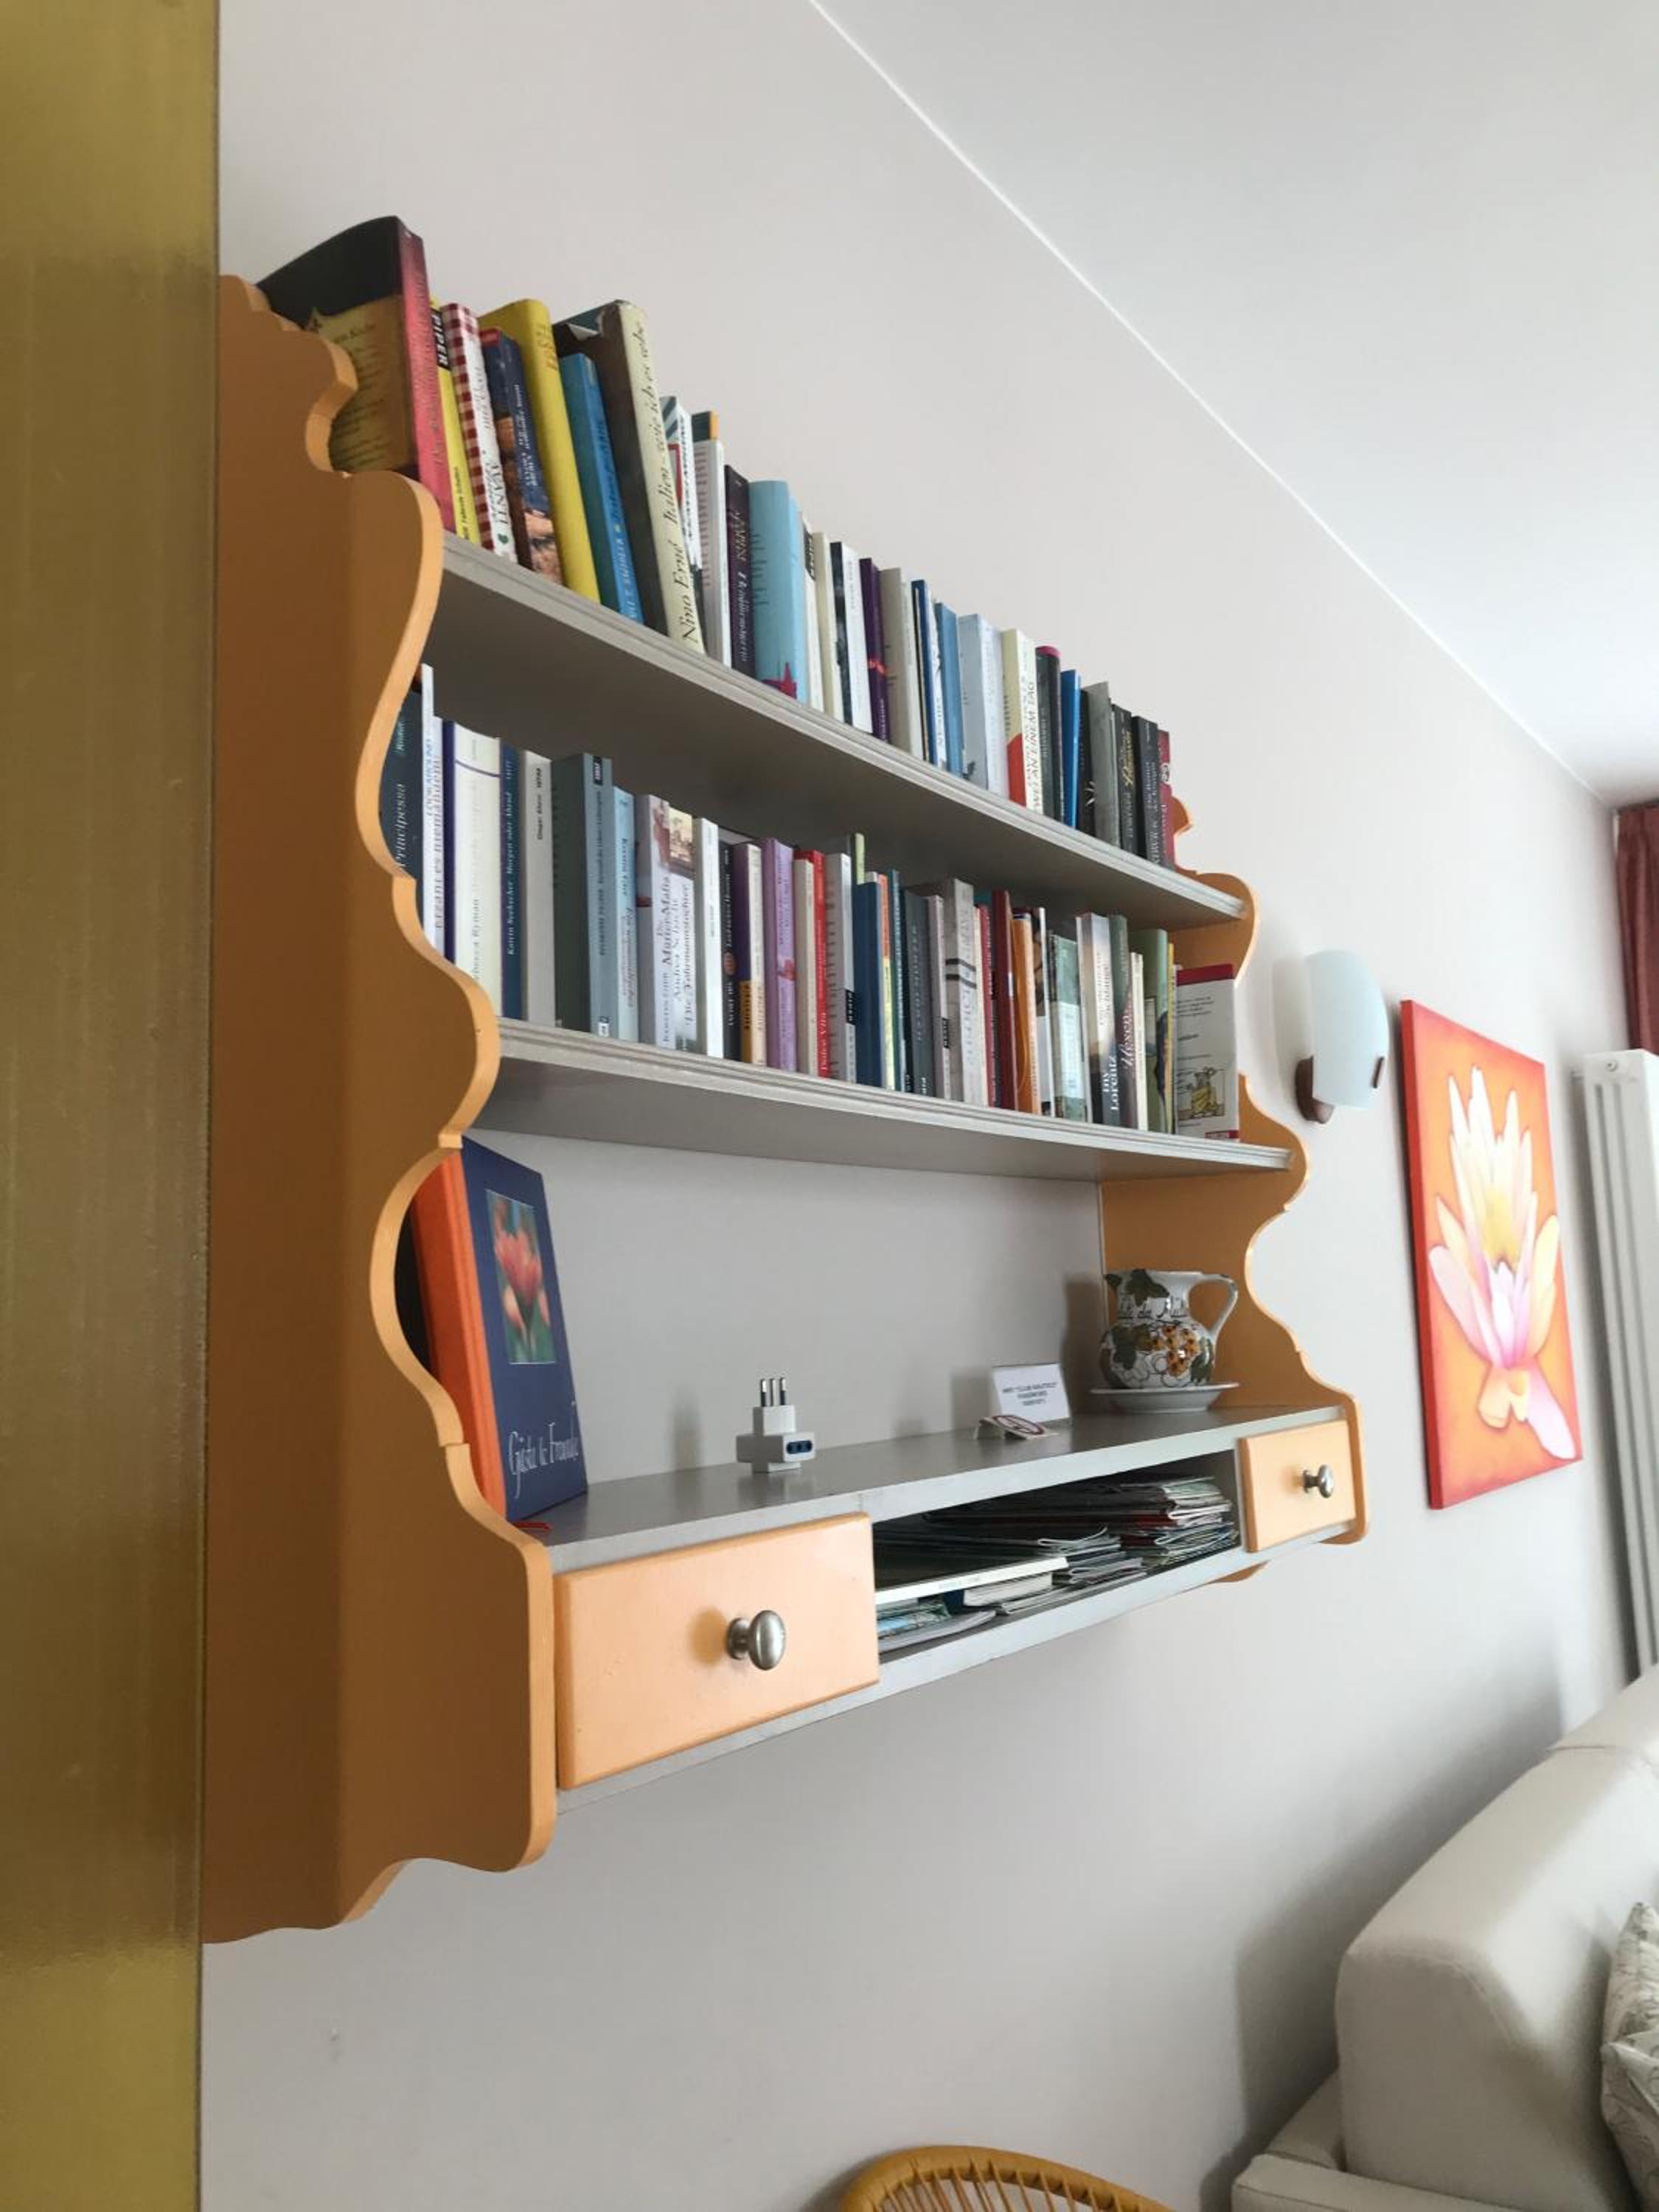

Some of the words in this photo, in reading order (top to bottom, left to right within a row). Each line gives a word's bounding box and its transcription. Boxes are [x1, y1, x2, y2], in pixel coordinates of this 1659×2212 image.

[432, 314, 448, 367] PIPER
[680, 595, 699, 644] Nino
[1108, 1054, 1119, 1111] Lorentz
